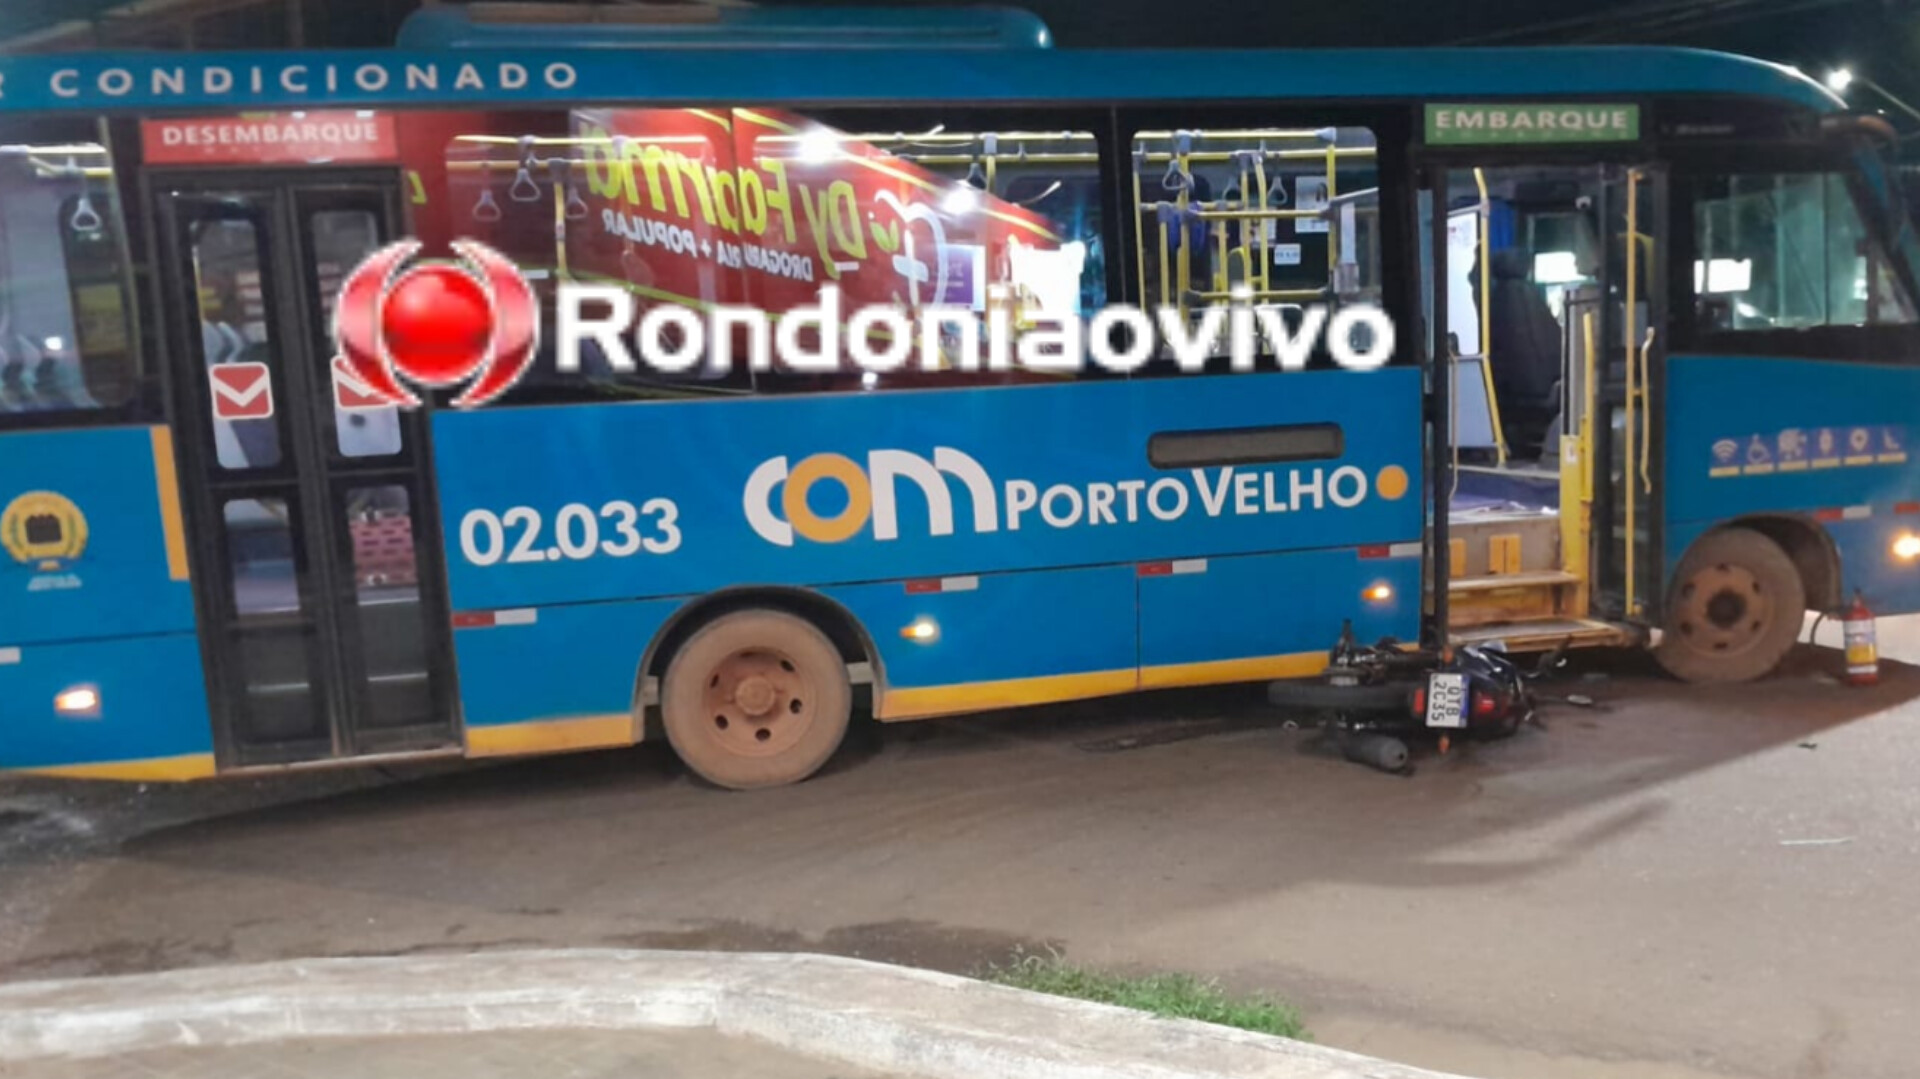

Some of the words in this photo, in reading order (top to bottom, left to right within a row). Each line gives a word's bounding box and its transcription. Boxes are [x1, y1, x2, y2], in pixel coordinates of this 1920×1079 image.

[50, 62, 578, 98] CONDICIONADO
[162, 121, 379, 146] DESEMBARQUE
[1435, 109, 1629, 131] EMBARQUE
[460, 497, 683, 567] 02.033
